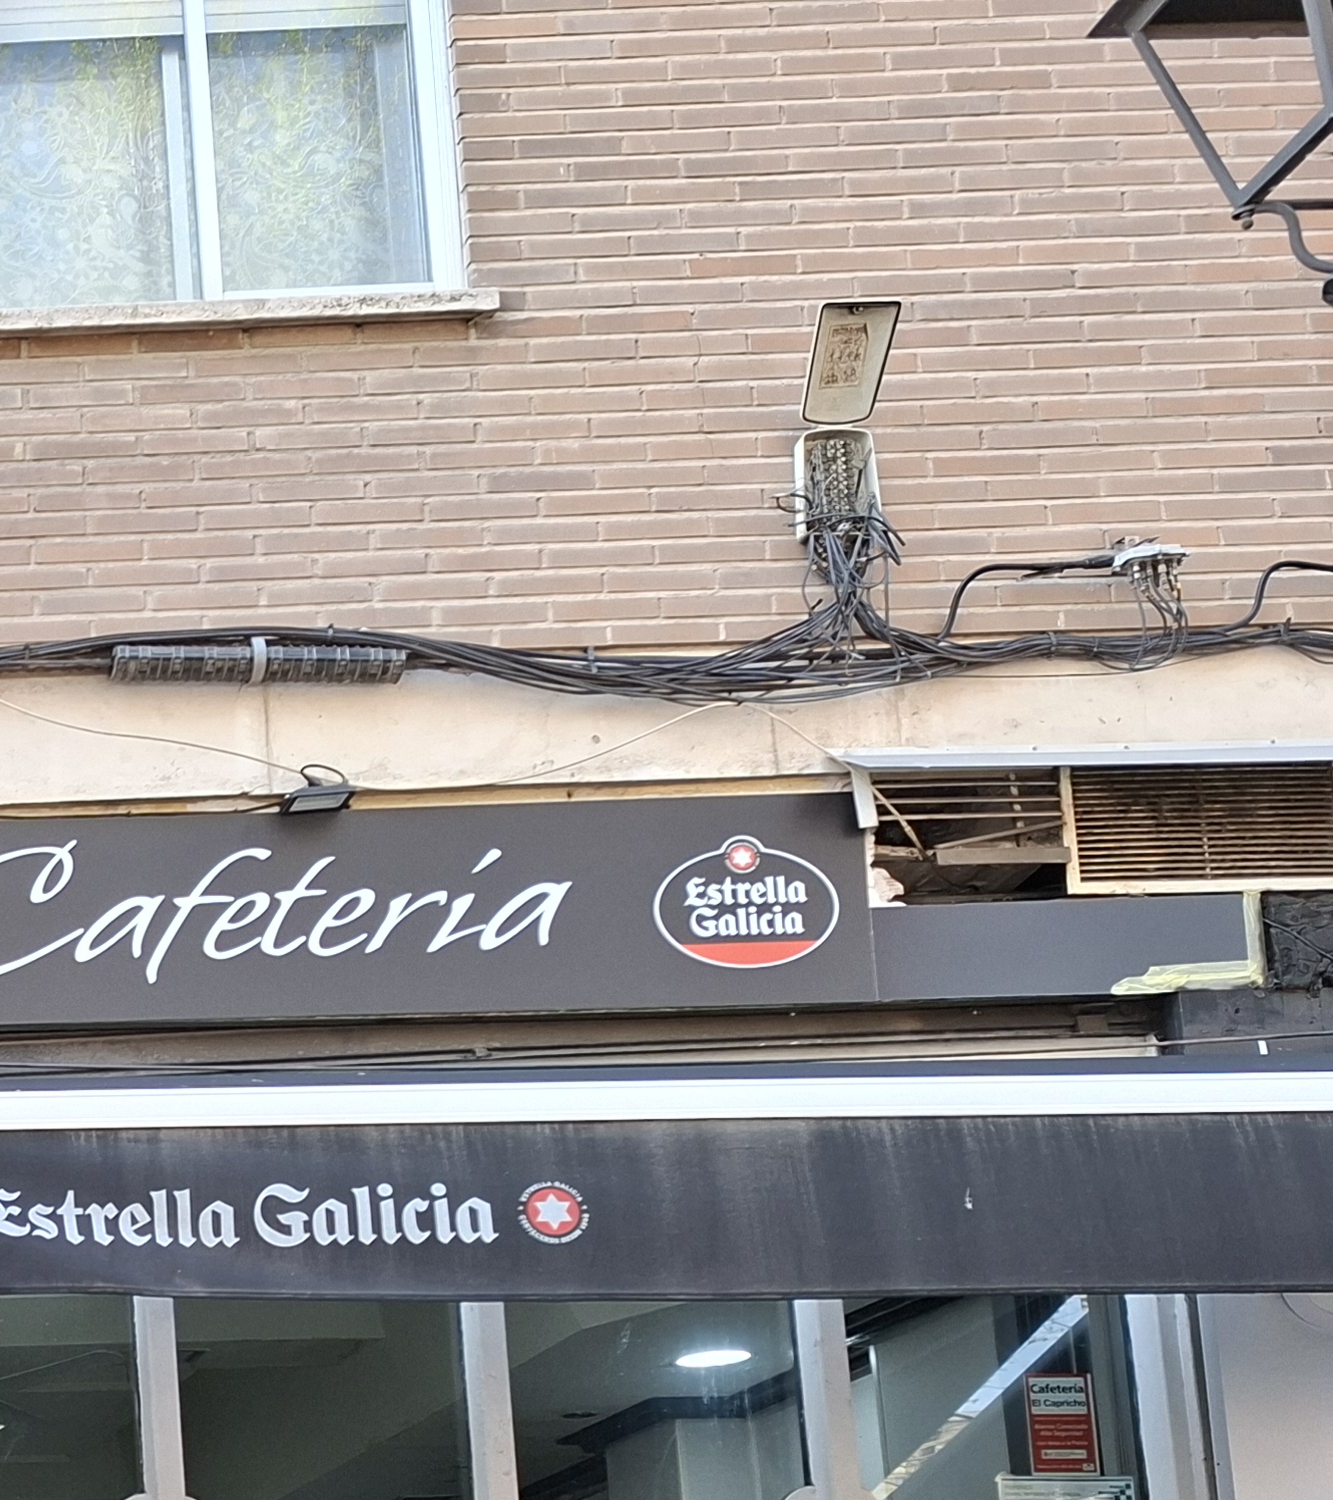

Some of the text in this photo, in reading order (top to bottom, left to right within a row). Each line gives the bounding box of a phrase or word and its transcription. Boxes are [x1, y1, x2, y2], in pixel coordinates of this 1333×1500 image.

[683, 876, 809, 908] Estrella
[689, 905, 805, 938] Galicia
[253, 1181, 500, 1249] Galicia
[1030, 1383, 1085, 1394] Cafetería
[1032, 1398, 1087, 1408] El Capricho
